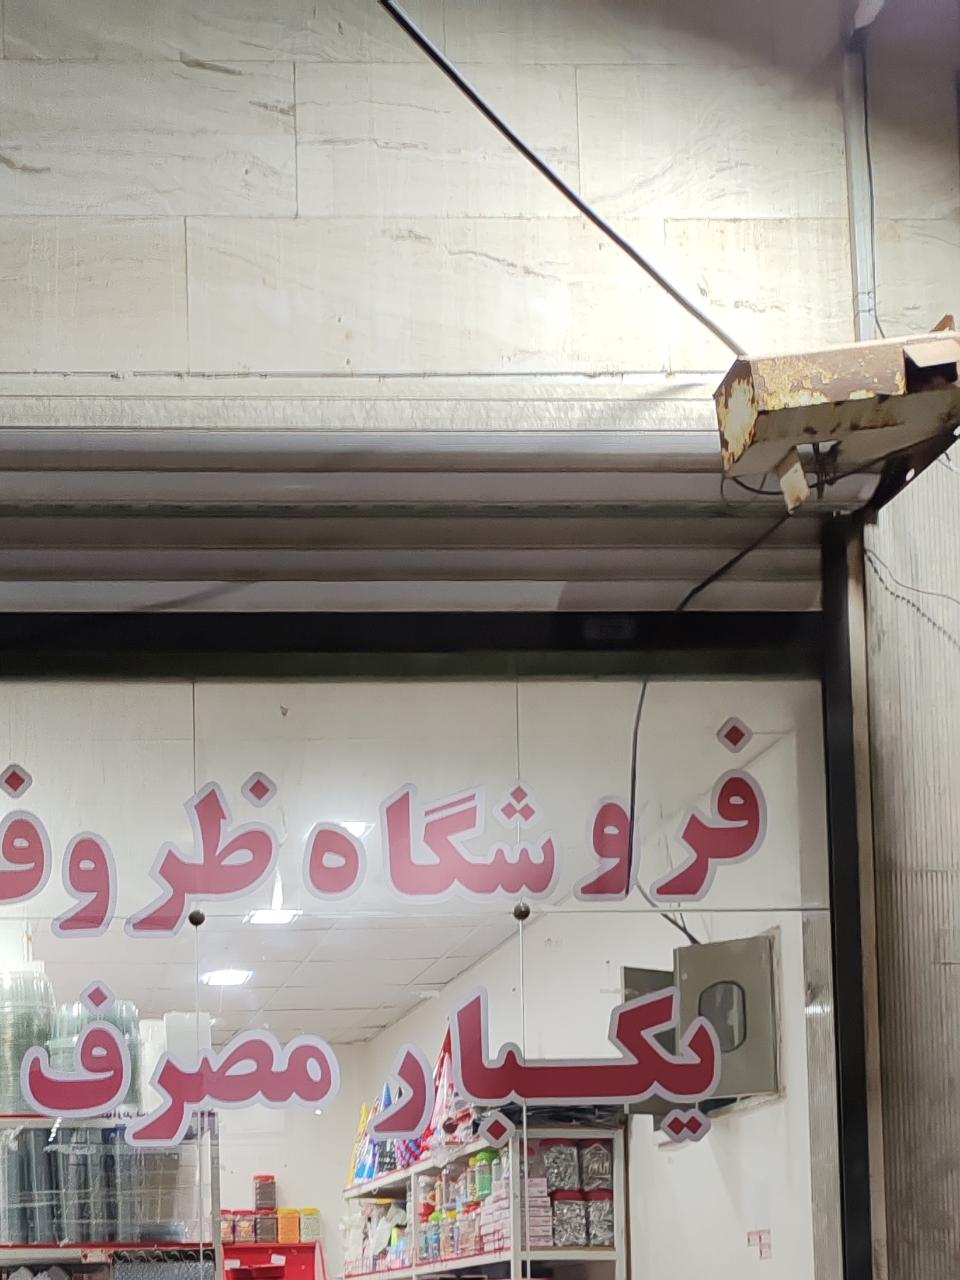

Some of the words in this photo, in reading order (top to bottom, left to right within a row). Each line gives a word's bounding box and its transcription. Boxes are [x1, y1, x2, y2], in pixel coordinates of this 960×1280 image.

[302, 717, 768, 902] فروشگاه
[21, 981, 341, 1146] مصرف
[368, 987, 721, 1146] یکبار
